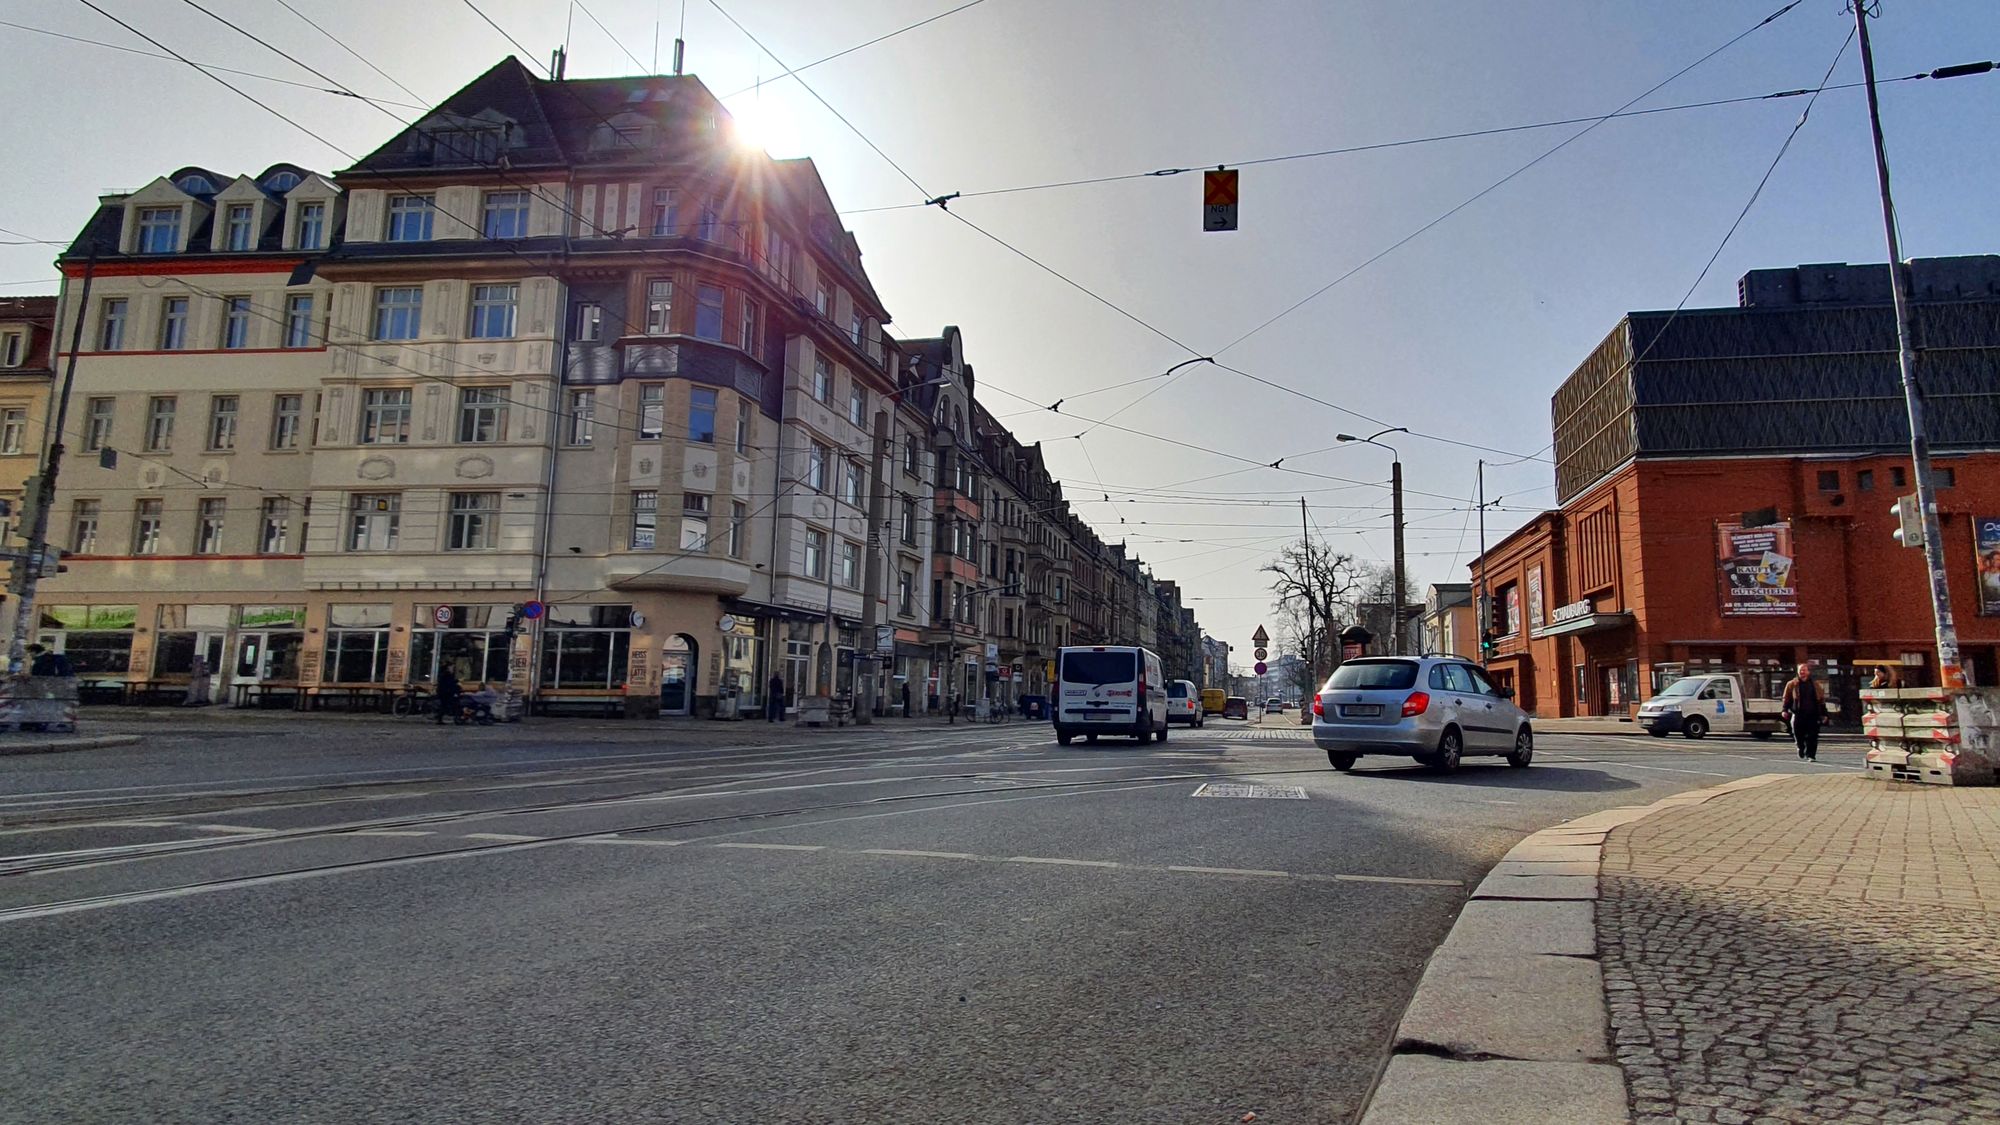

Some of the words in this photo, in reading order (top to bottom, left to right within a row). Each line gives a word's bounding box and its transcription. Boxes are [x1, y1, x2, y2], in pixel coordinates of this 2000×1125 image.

[1211, 205, 1229, 213] NGT
[438, 609, 449, 619] 30
[1552, 599, 1591, 623] SCHAUBURG
